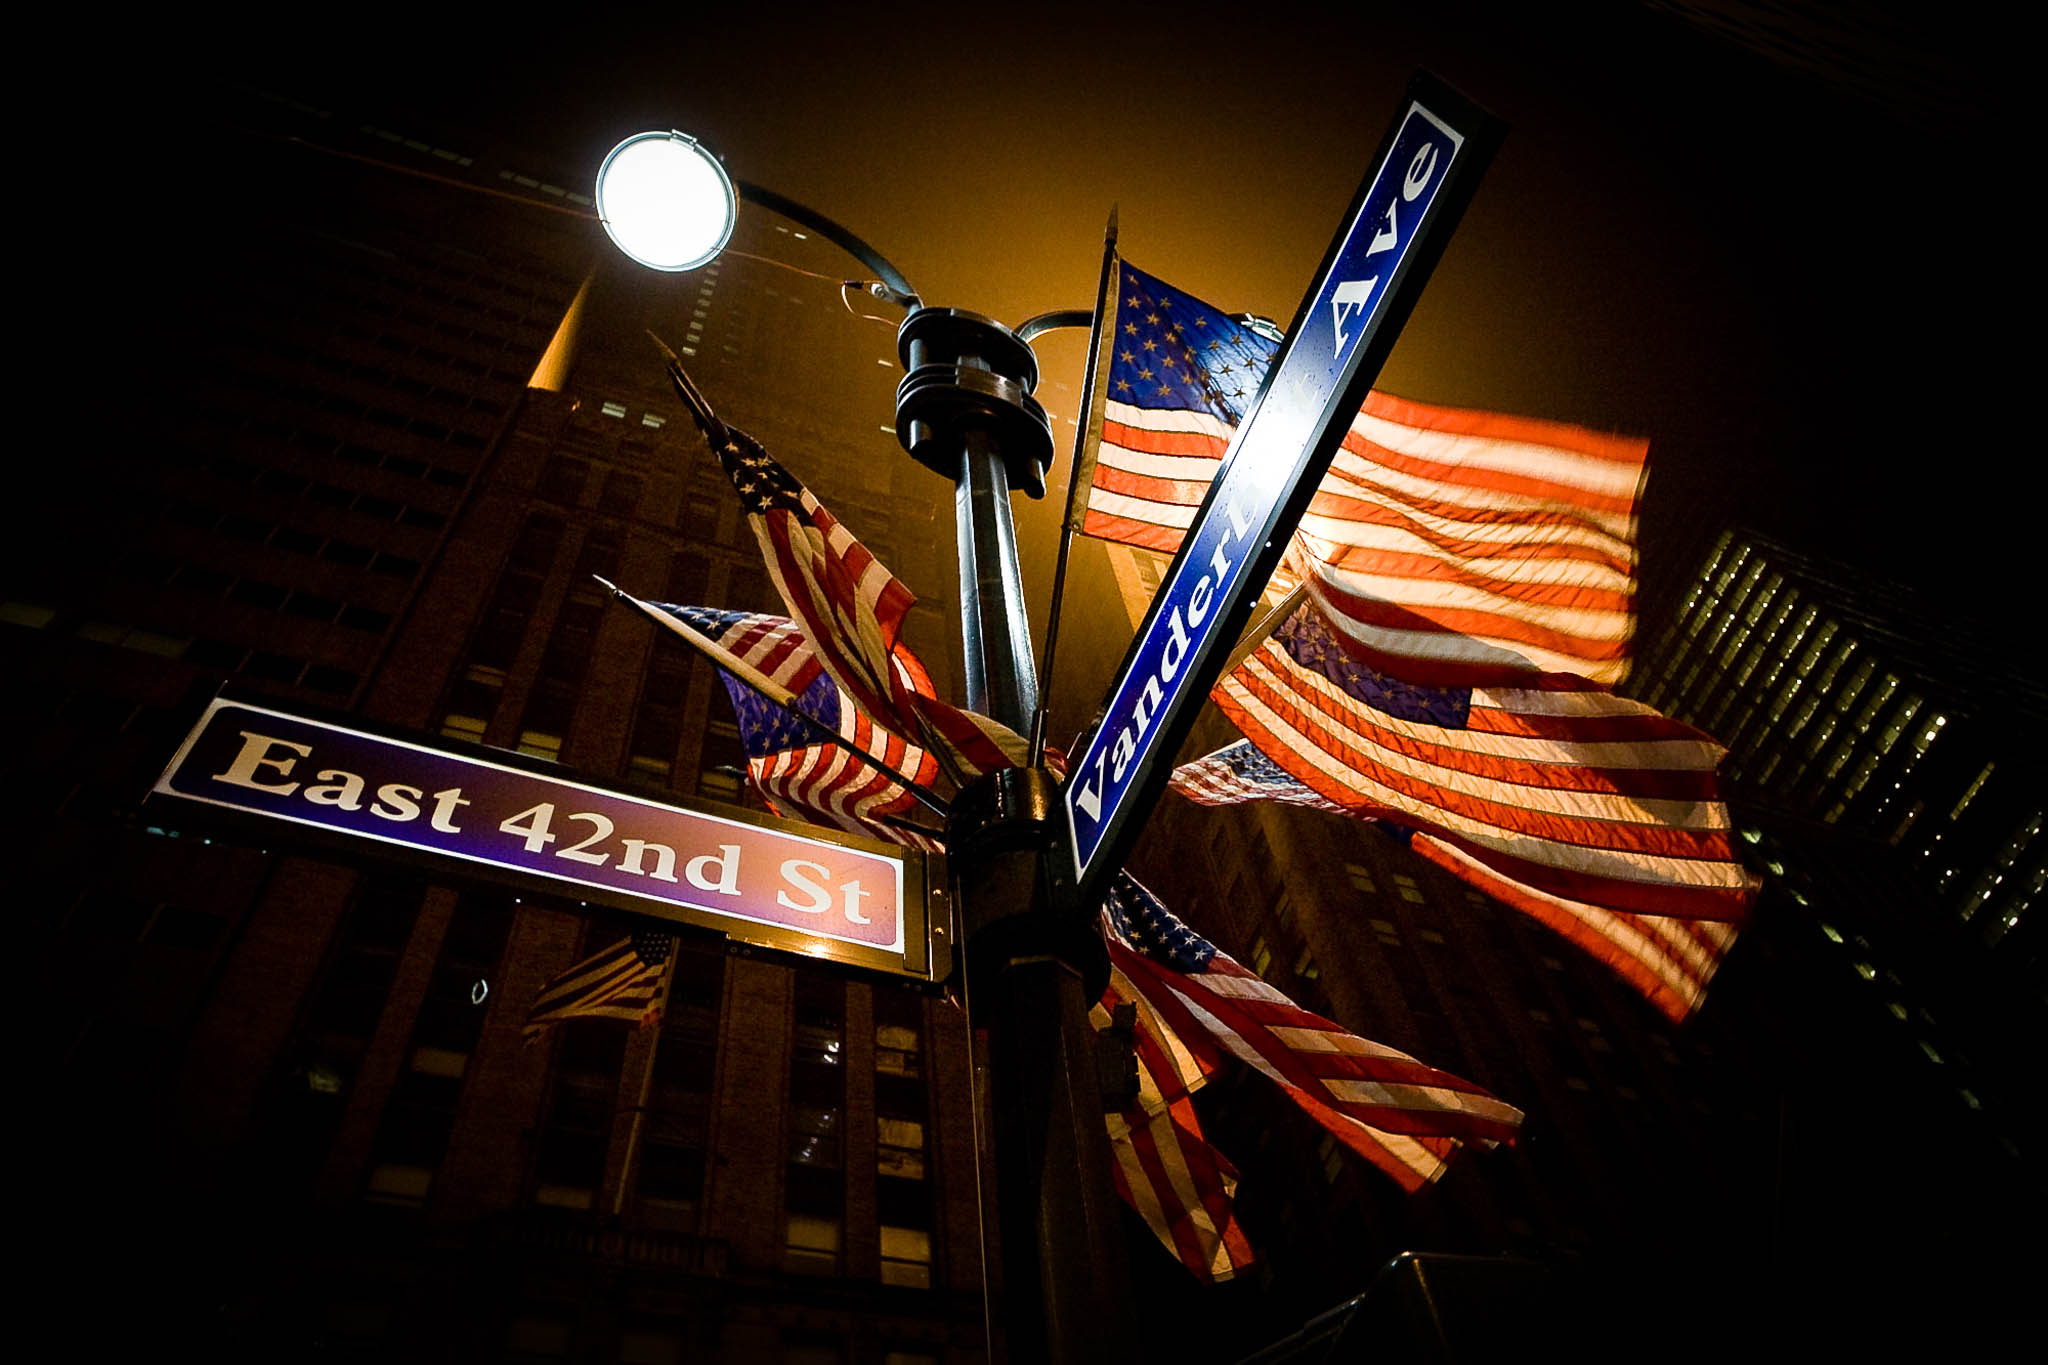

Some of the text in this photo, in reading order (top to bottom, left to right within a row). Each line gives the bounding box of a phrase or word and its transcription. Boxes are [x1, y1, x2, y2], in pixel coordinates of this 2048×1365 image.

[1330, 142, 1438, 360] Ave
[211, 731, 872, 924] East 42nd St
